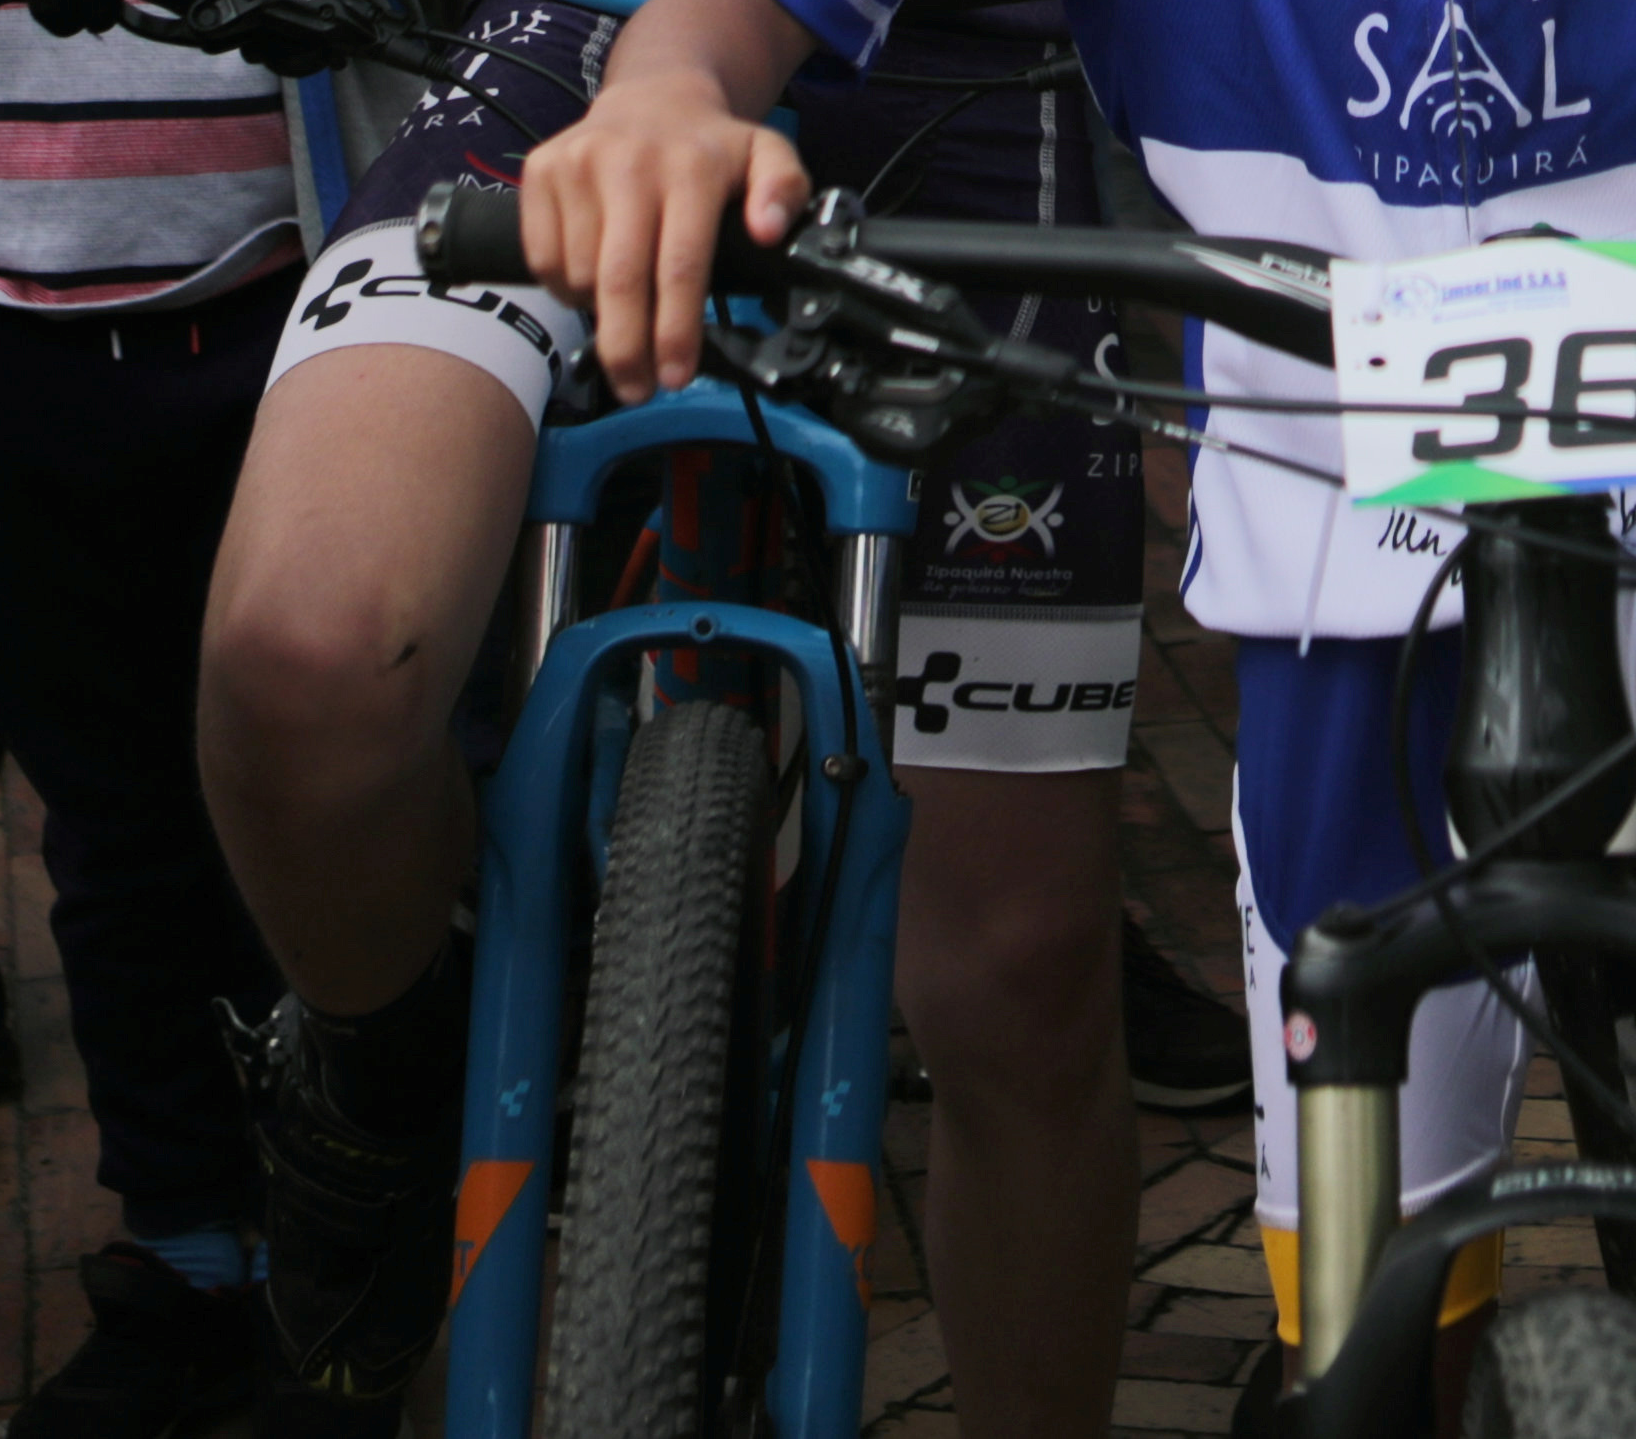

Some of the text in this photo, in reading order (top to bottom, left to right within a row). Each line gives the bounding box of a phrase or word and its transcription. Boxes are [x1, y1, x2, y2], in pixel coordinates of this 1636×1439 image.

[1356, 134, 1589, 189] IPAQUIRÁ
[925, 564, 1074, 582] Zipaquirá Nuestra
[951, 678, 1136, 714] CUBE
